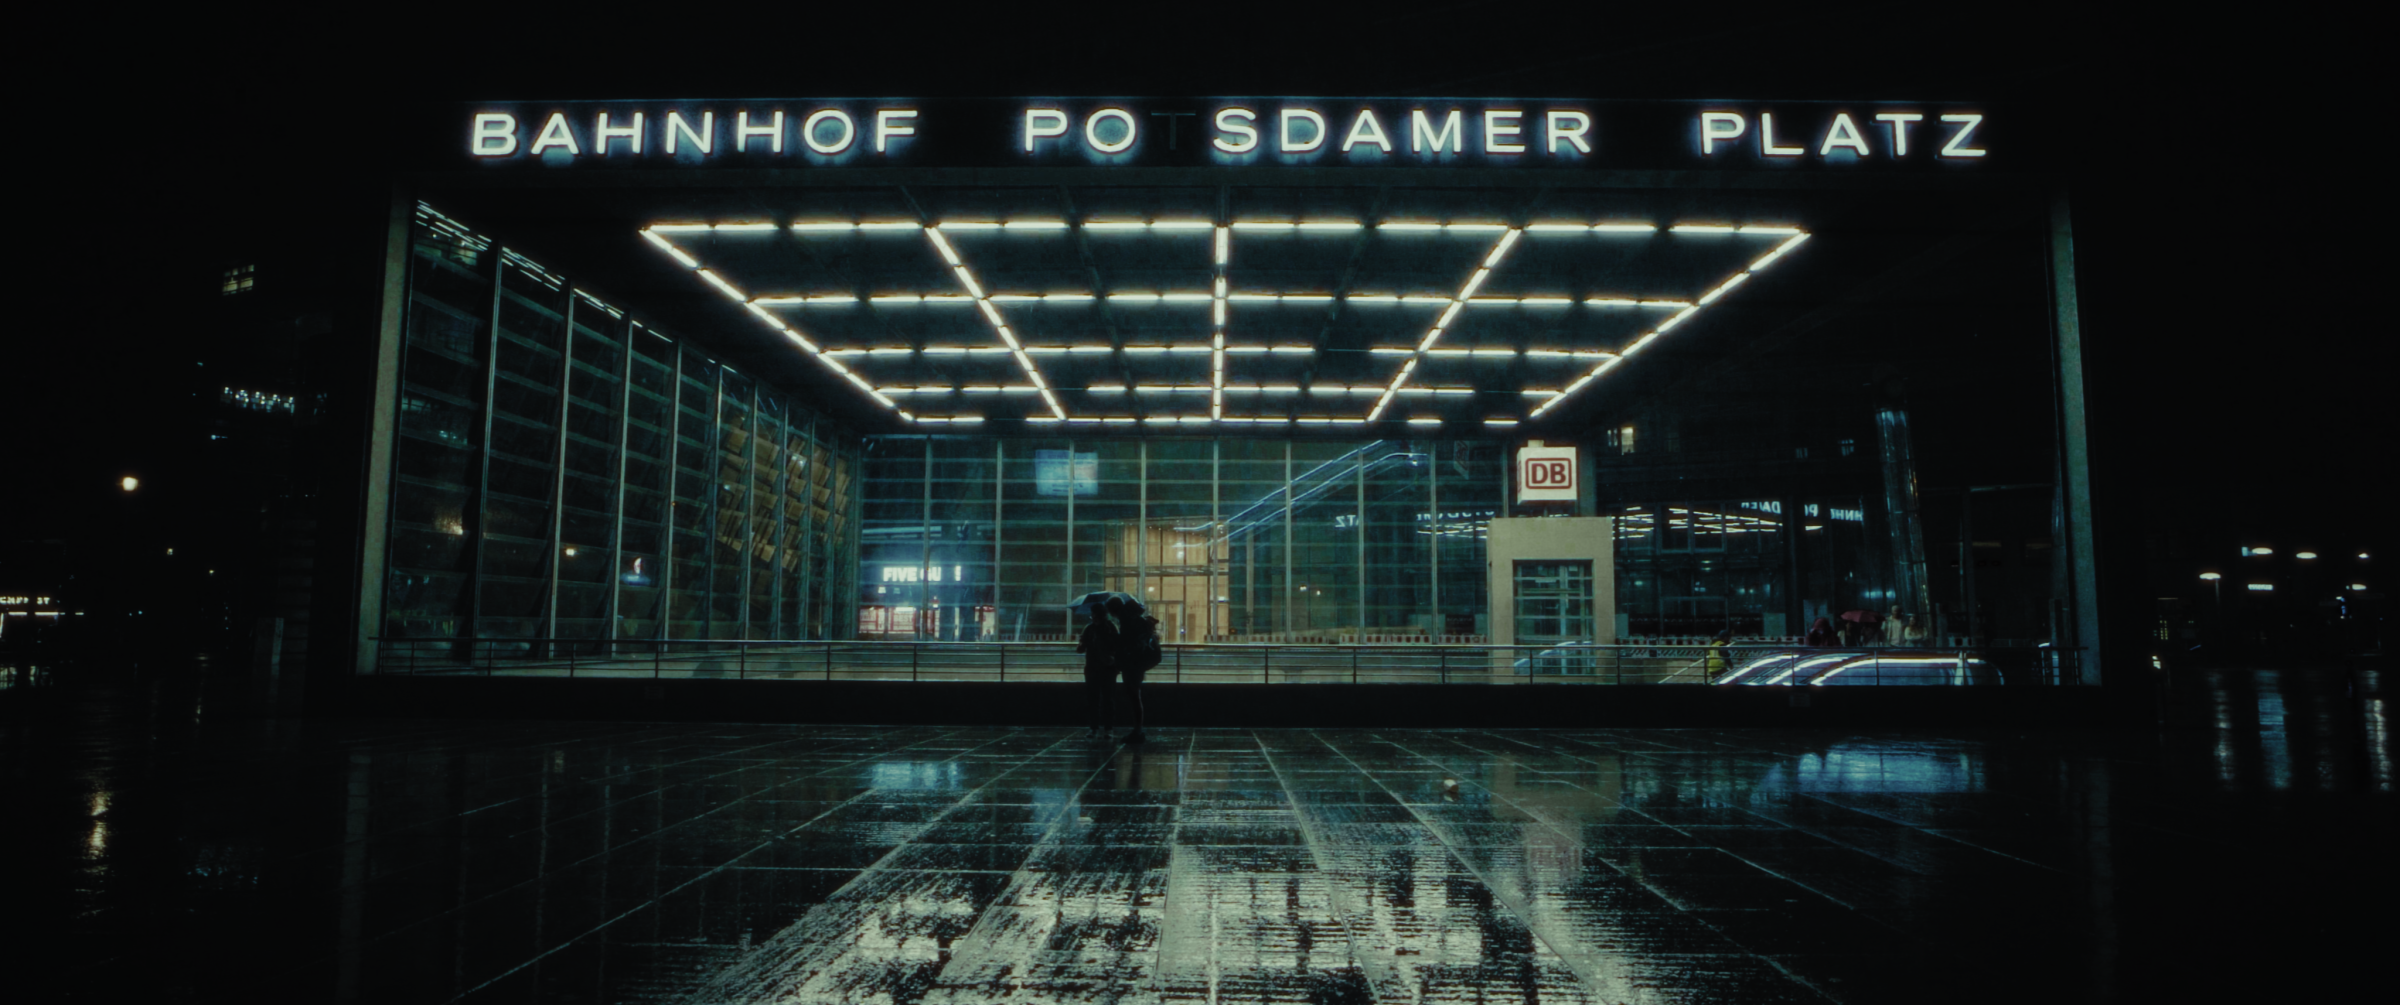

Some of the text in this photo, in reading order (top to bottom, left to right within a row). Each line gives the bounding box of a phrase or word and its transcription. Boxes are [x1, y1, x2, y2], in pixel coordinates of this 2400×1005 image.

[473, 110, 917, 155] BAHNHOF
[1702, 113, 1985, 156] PLATZ
[1531, 463, 1566, 484] DB
[883, 567, 917, 581] FIVE
